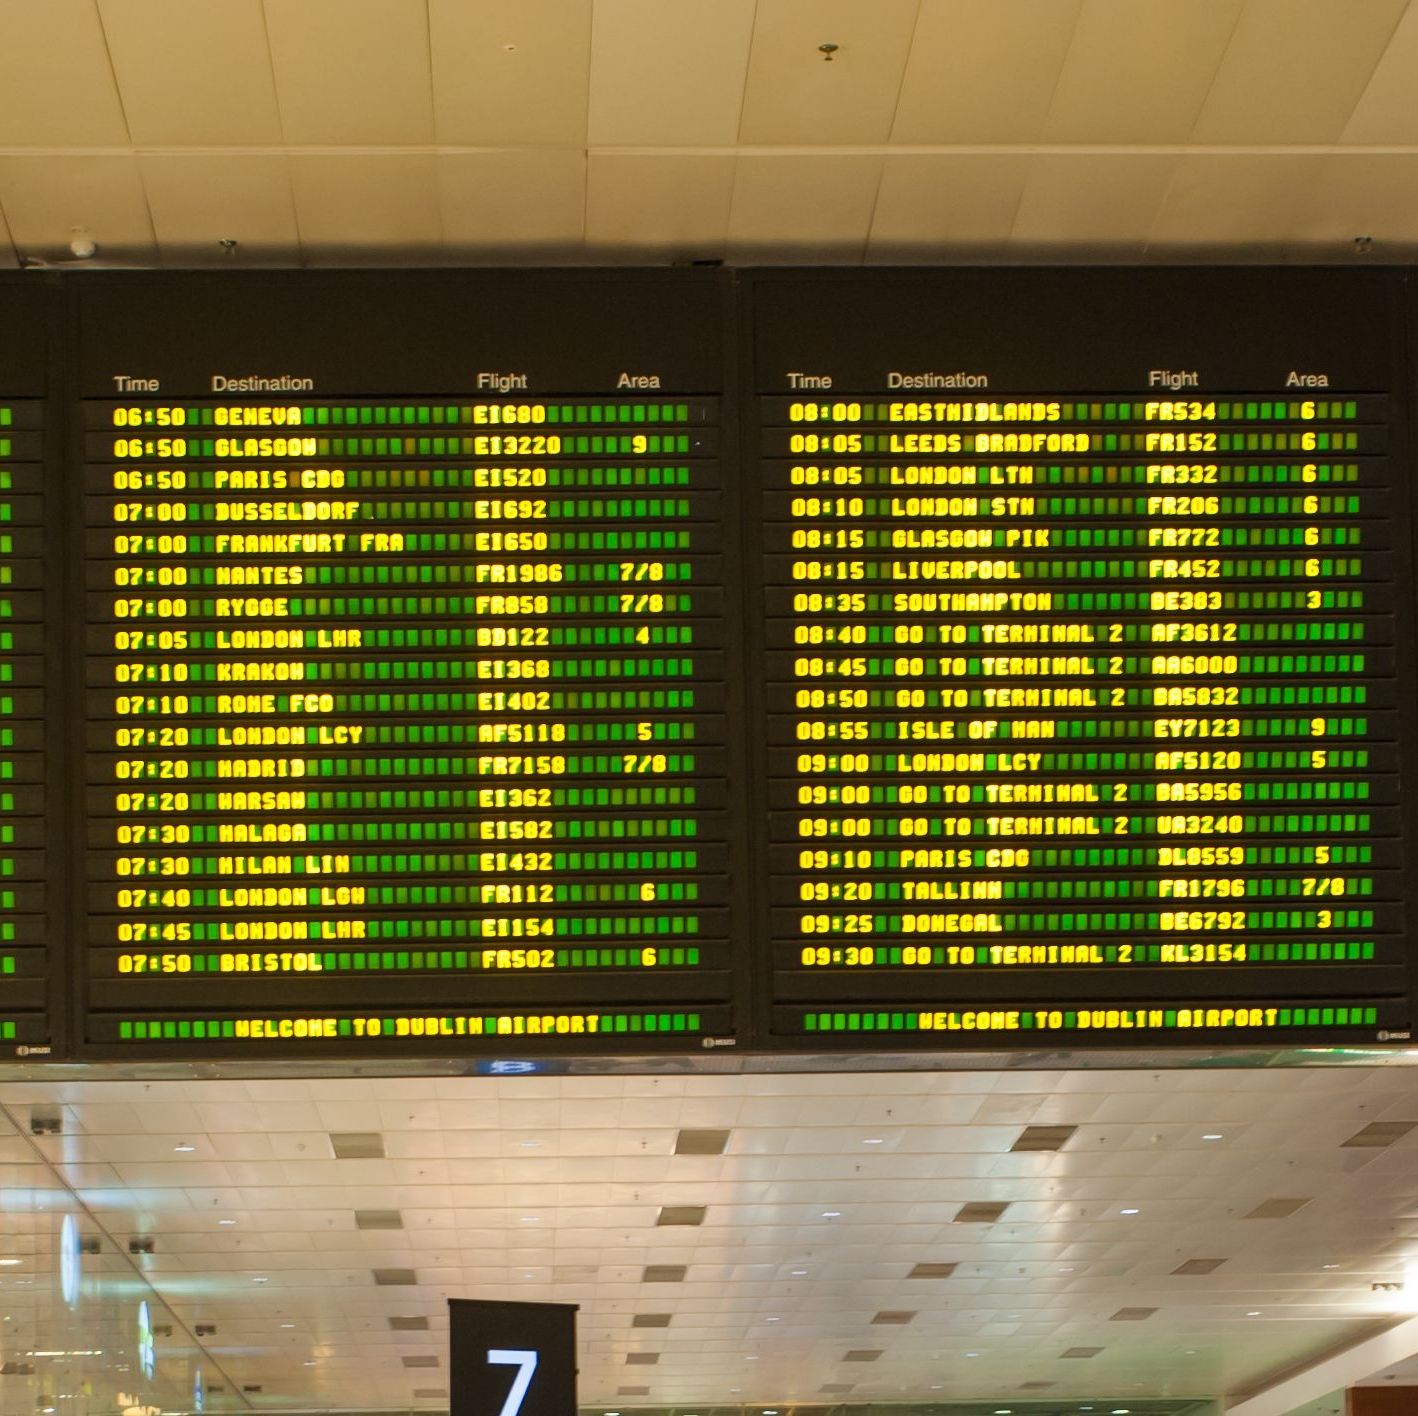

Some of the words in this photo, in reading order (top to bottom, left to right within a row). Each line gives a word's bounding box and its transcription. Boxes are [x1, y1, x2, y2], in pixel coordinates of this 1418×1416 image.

[114, 375, 160, 392] Time
[212, 374, 313, 392] Destination
[477, 372, 527, 391] Flight
[618, 373, 661, 389] Area
[787, 373, 832, 389] Time
[887, 372, 988, 389] Destination
[1149, 370, 1198, 388] Flight
[1287, 372, 1329, 387] Area
[113, 407, 186, 426] 06:50
[214, 406, 302, 426] GENEVA
[473, 404, 546, 424] EI680
[789, 403, 861, 422] 08:00
[889, 402, 1061, 422] EASTMIDLANDS
[1145, 401, 1216, 421] FR534
[1300, 401, 1315, 420] 6
[114, 502, 187, 522] 07:00
[215, 501, 360, 521] DUSSELDORF
[474, 500, 547, 519] EI692
[794, 625, 867, 644] 08:40
[894, 625, 924, 644] GO
[939, 625, 967, 644] TO
[981, 624, 1095, 643] TERMINAL
[1109, 623, 1123, 643] 2
[1151, 623, 1237, 642] AF3612
